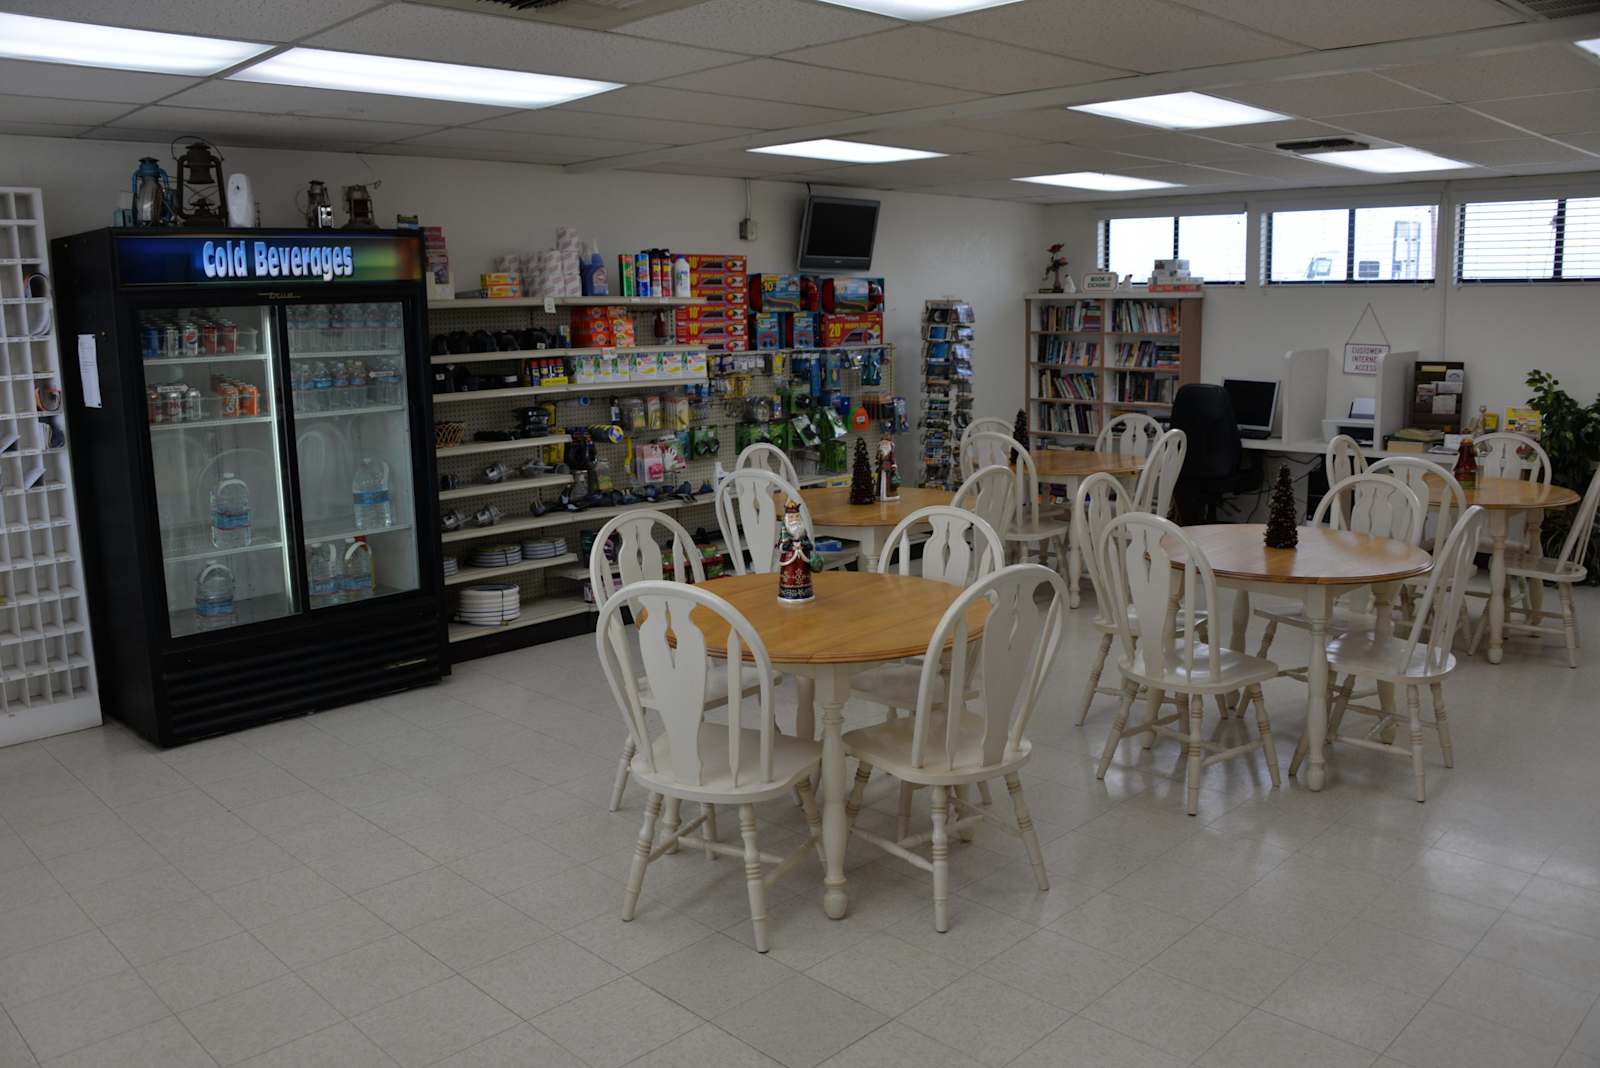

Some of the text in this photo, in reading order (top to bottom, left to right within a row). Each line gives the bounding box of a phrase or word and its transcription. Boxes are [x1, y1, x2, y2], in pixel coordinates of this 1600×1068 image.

[203, 240, 354, 281] Cold Beverages
[1351, 355, 1377, 363] INTERNE
